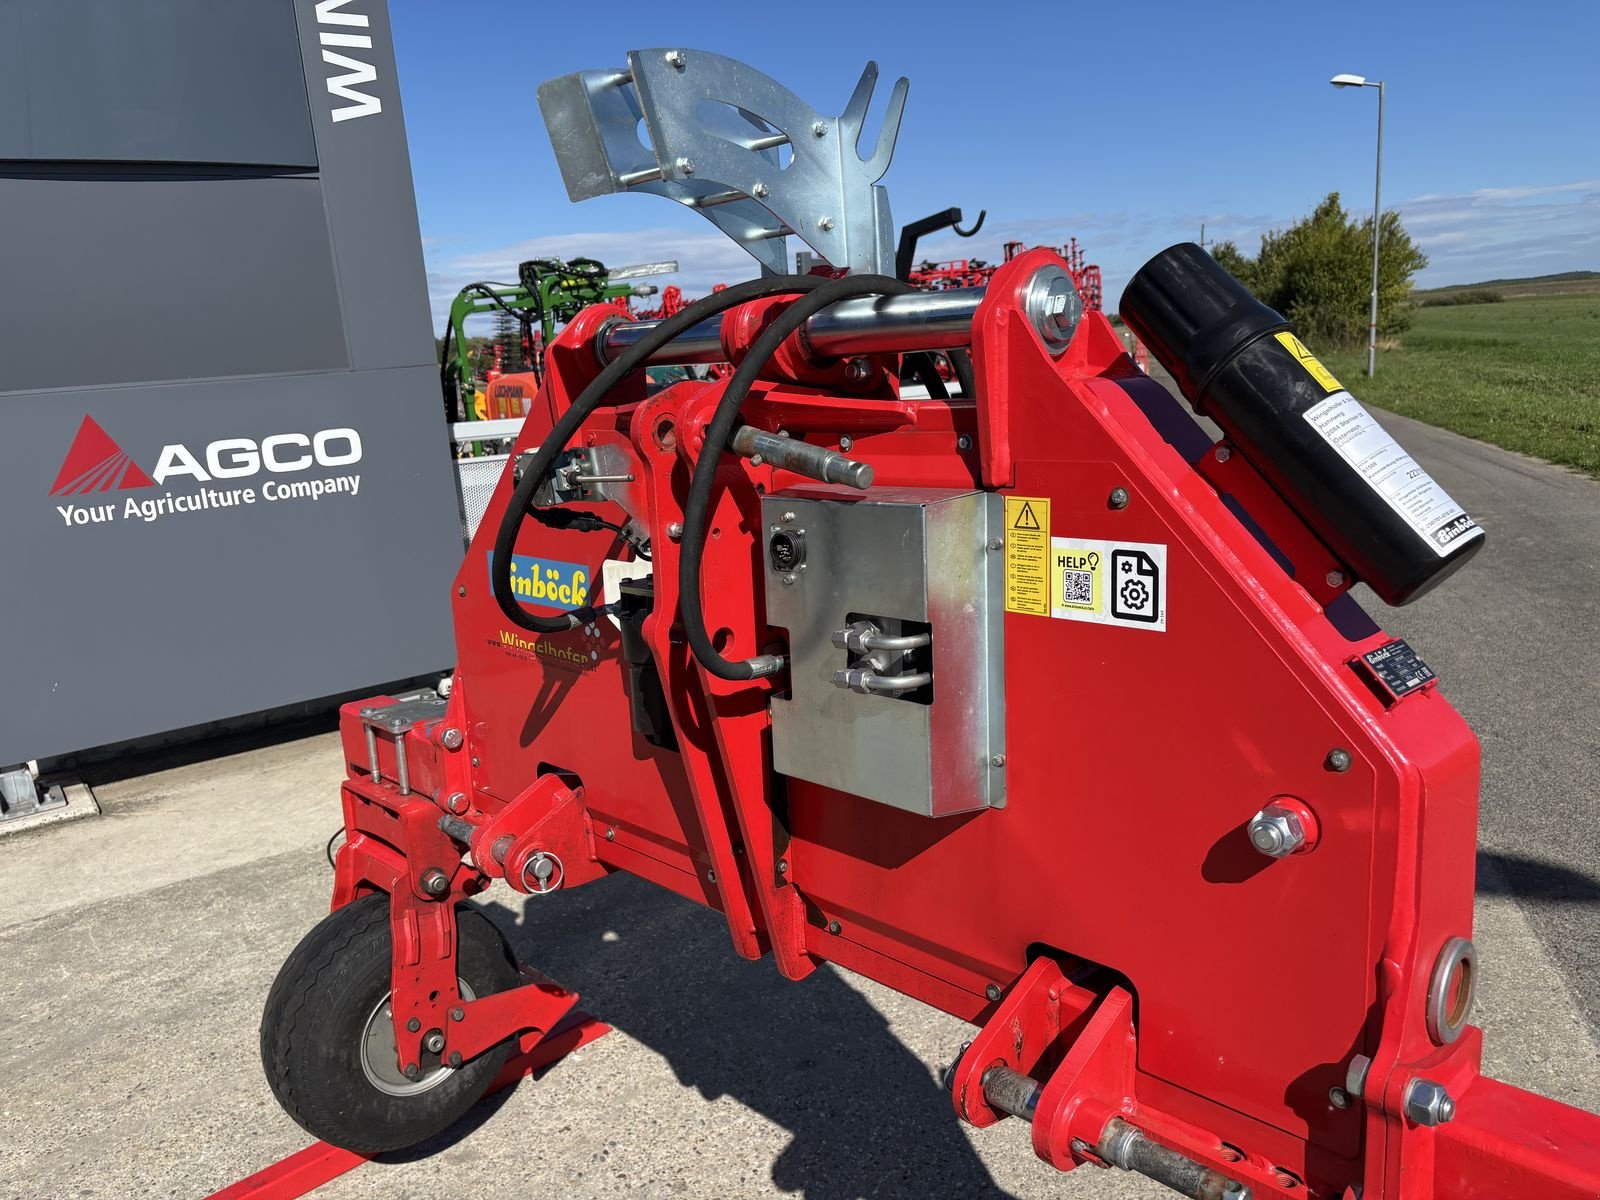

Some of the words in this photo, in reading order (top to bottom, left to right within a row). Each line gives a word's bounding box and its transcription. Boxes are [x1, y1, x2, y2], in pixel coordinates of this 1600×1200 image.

[152, 428, 363, 486] AGCO
[57, 502, 116, 526] Your
[123, 487, 256, 522] Agriculture
[262, 474, 361, 505] Company
[510, 562, 587, 606] inböck
[1057, 555, 1087, 570] HELP
